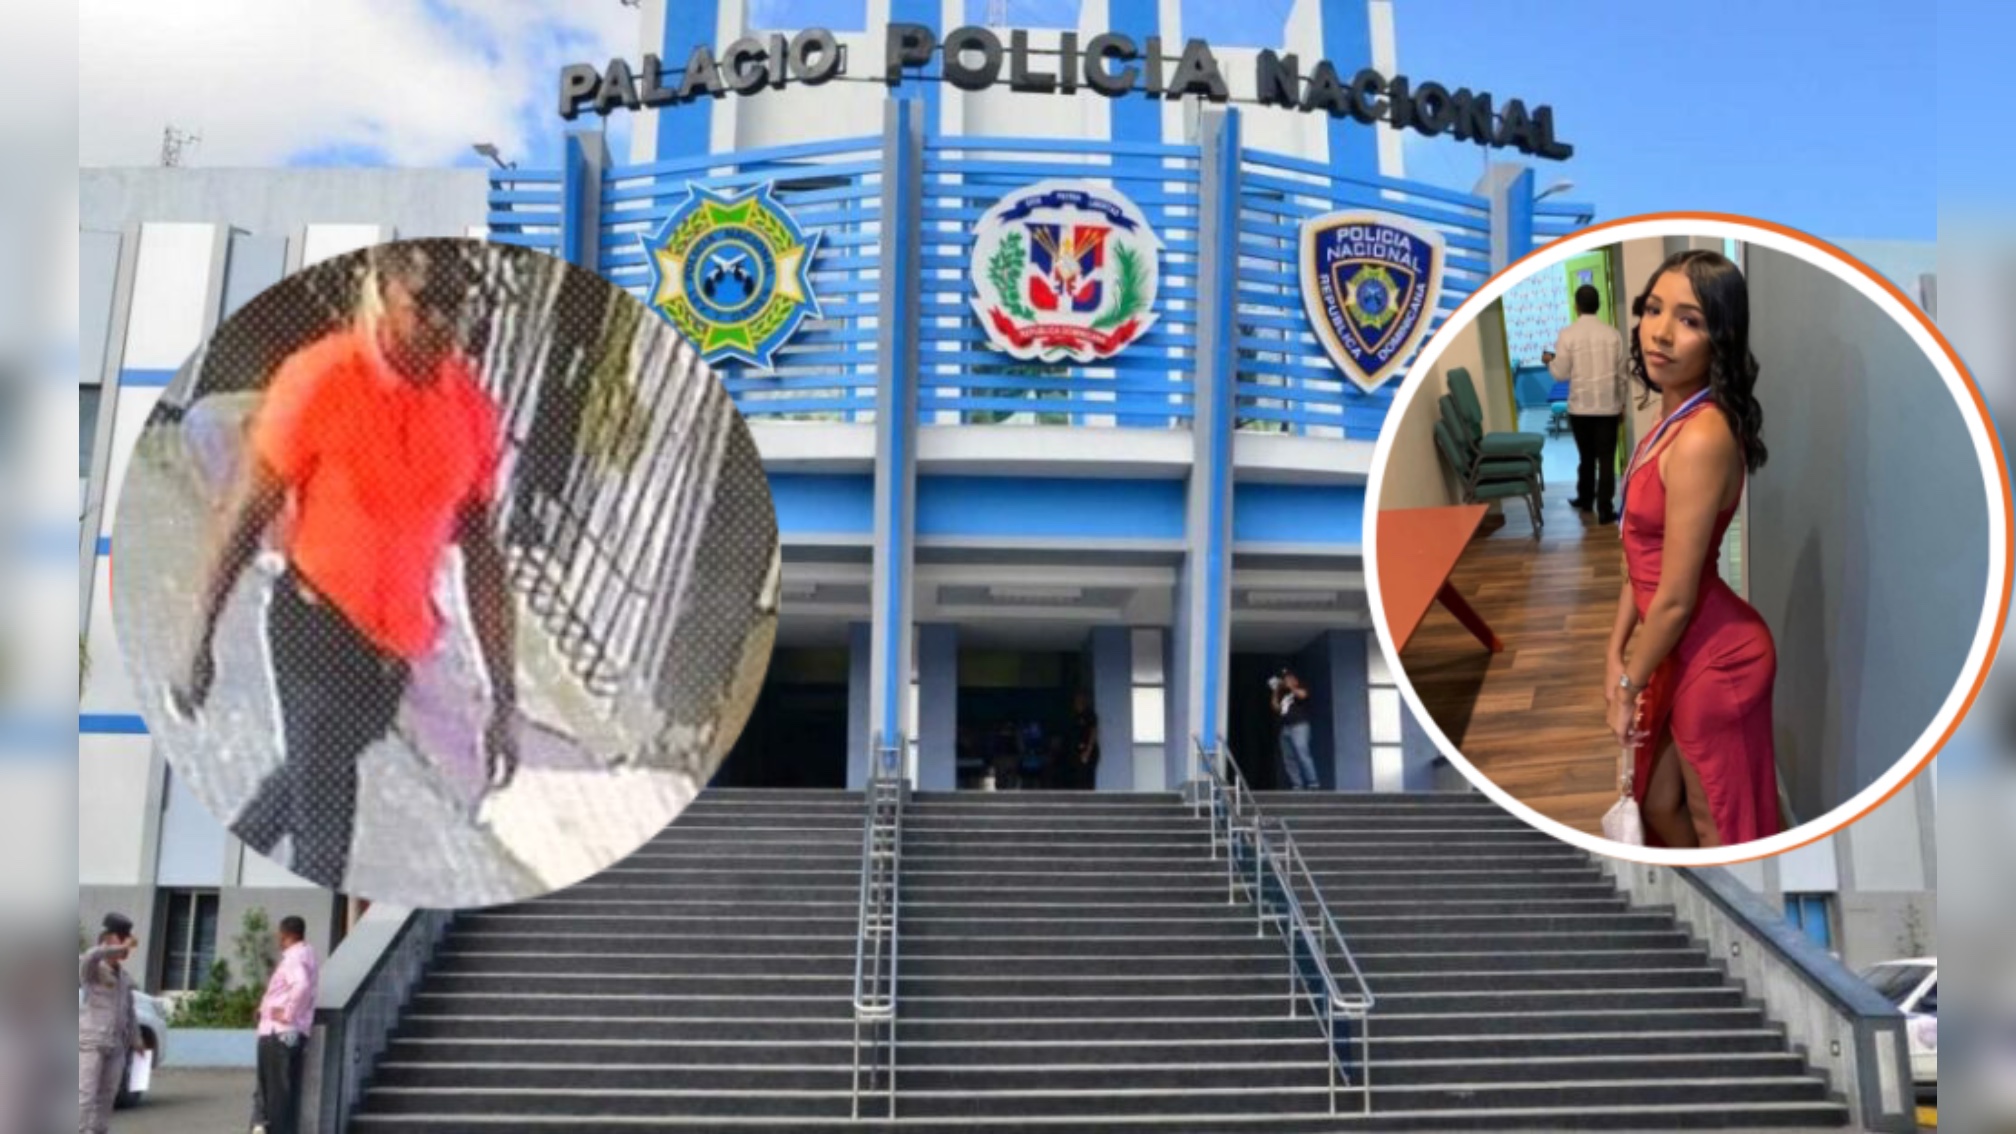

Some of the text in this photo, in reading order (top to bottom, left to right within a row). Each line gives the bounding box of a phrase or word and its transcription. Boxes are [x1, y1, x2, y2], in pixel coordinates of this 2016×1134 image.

[560, 22, 1574, 161] PALACIO POLICIA NACIONAL
[1327, 243, 1422, 273] NACIONAL
[1336, 226, 1411, 250] POLICIA
[1320, 274, 1426, 361] REPUBLICA DOMINICANA
